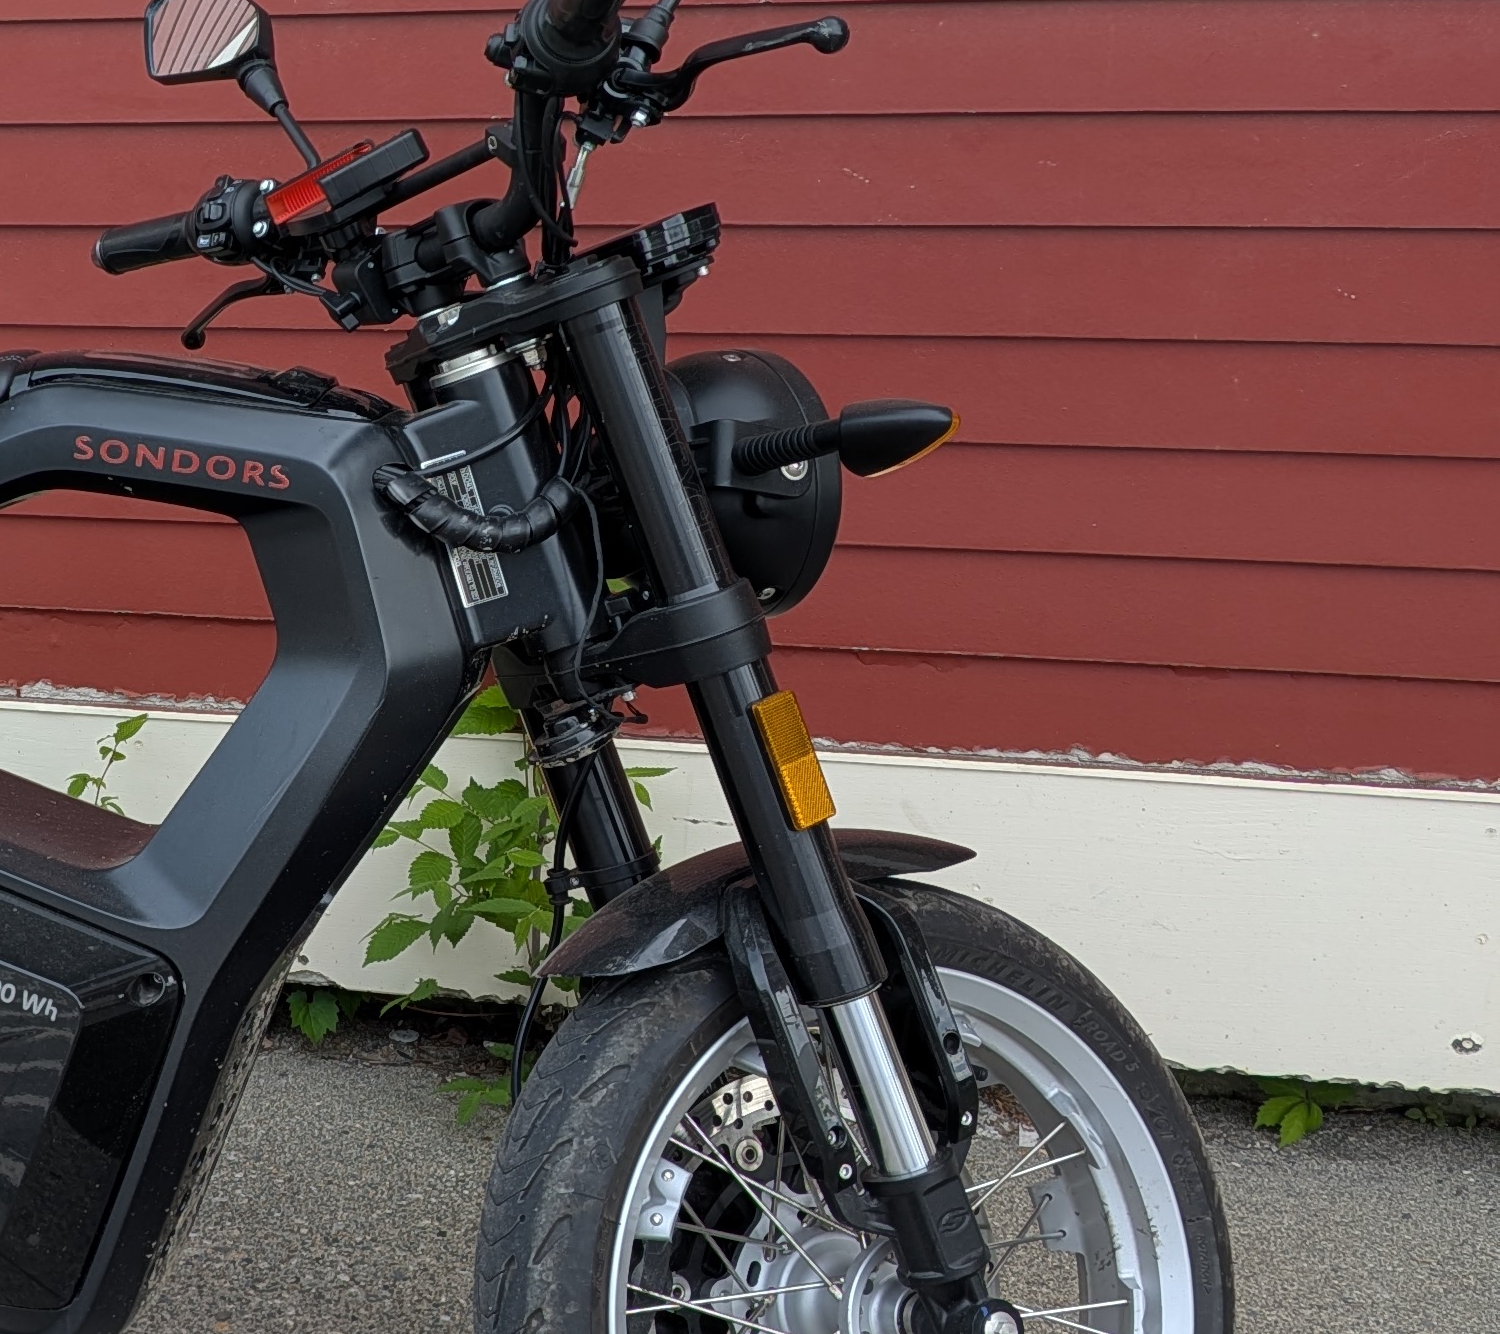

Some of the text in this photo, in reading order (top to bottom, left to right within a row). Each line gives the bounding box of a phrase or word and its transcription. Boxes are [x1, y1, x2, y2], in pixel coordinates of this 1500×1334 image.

[73, 435, 291, 490] SONDORS
[931, 939, 1070, 1016] MICHELIN
[22, 990, 59, 1022] Wh
[1086, 1020, 1127, 1065] ROAD
